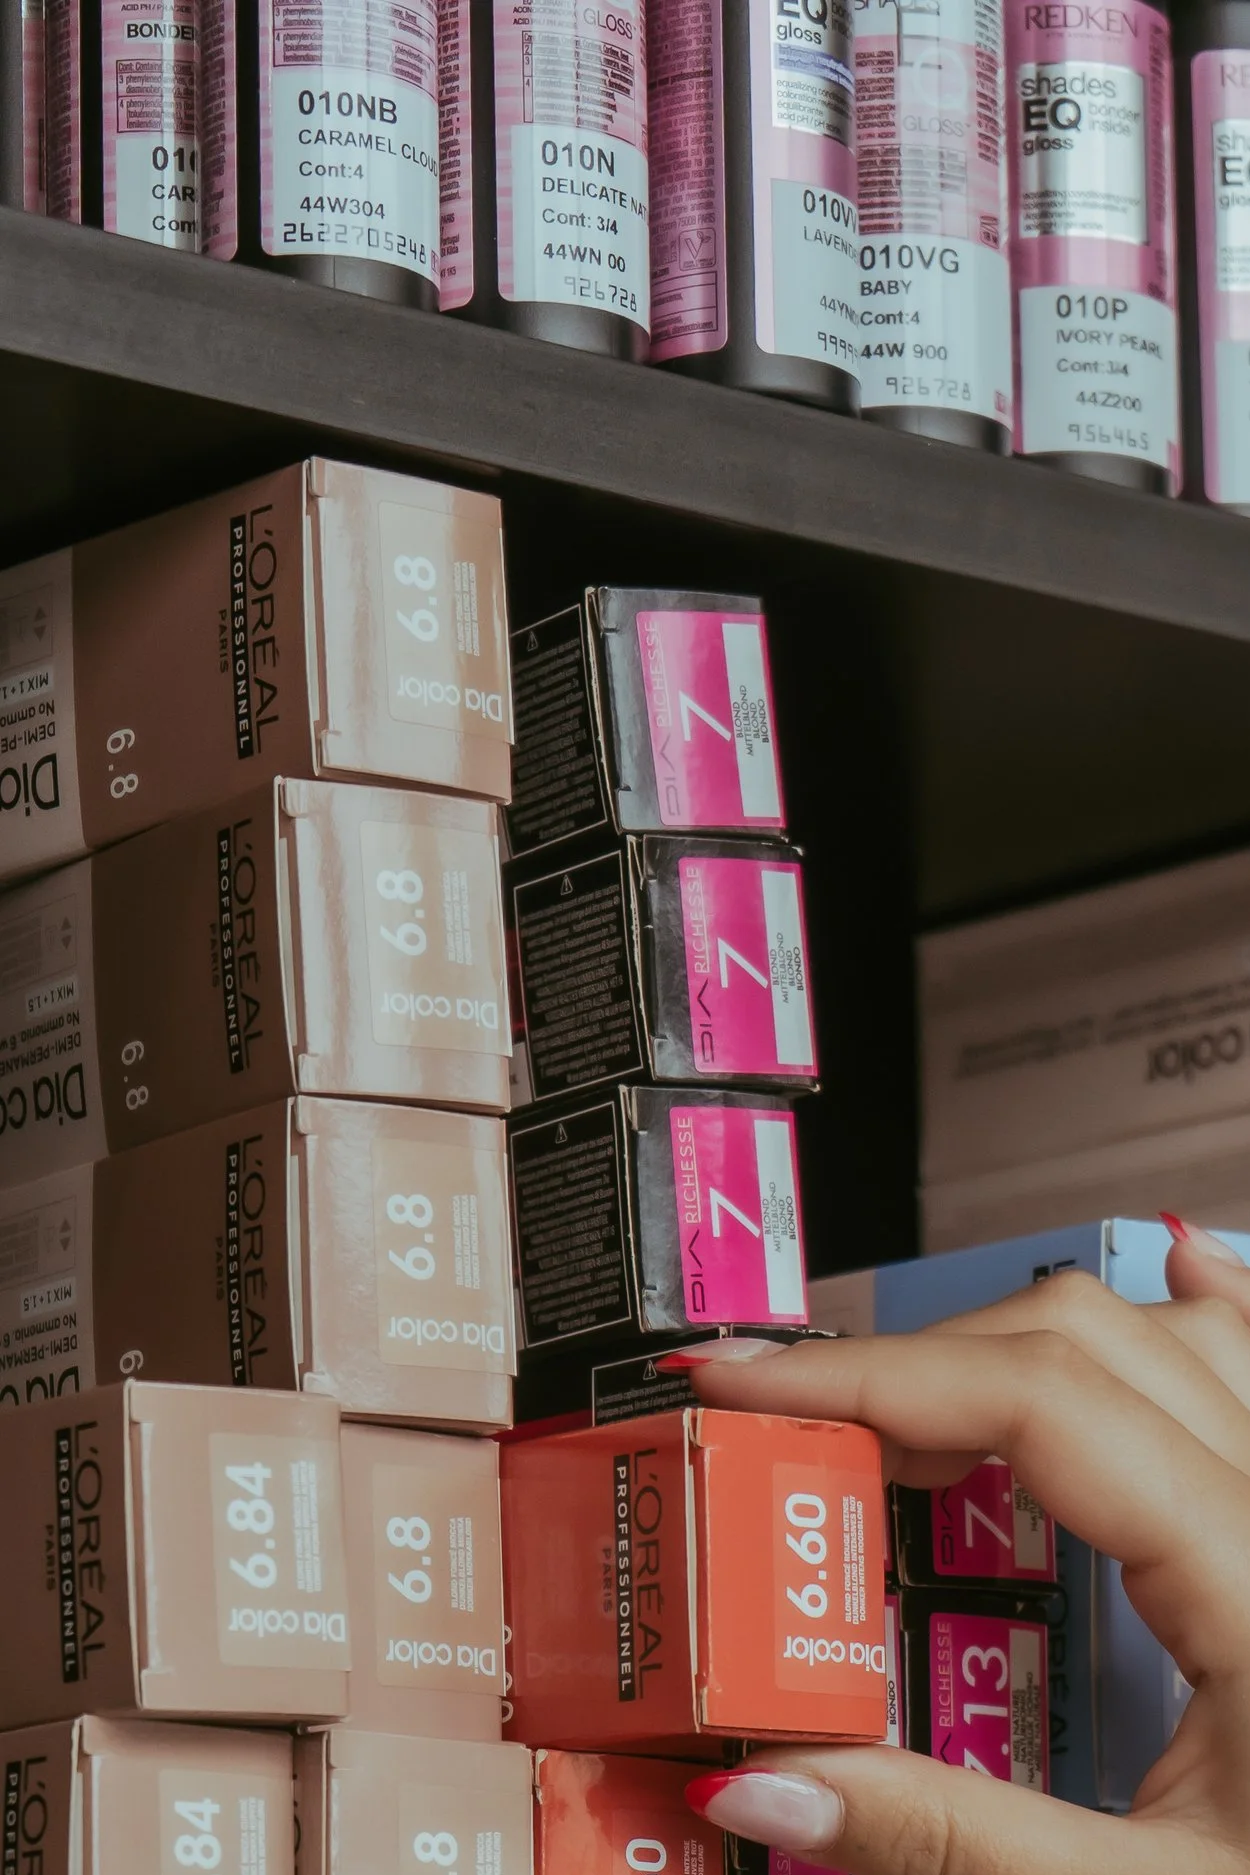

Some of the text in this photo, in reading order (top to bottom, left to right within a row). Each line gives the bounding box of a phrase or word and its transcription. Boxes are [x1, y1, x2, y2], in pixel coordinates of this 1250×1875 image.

[777, 22, 822, 44] gloss
[1025, 4, 1139, 38] REDKEN
[298, 90, 397, 124] 010NB
[1021, 72, 1117, 99] shades
[1023, 98, 1082, 132] EQ
[298, 129, 396, 156] CARAMEL
[541, 140, 616, 178] 010N
[1023, 135, 1074, 156] gloss
[299, 161, 364, 180] Cont:4
[542, 177, 628, 209] DELICATE
[300, 196, 385, 220] 44W304
[542, 208, 619, 236] Cont: 3/4
[283, 222, 427, 265] 2622705248
[543, 243, 626, 274] 44WN 00
[860, 244, 960, 274] 010VG
[564, 276, 637, 313] 926728
[861, 279, 912, 297] BABY
[1056, 294, 1128, 321] 010P
[860, 311, 920, 326] Cont:4
[861, 342, 948, 360] 44W 900
[1056, 329, 1164, 360] IVORY PEARL
[393, 555, 440, 643] 6.8
[217, 609, 229, 674] PARIS
[233, 525, 250, 750] PROFESSIONNEL
[248, 504, 280, 754] L'ORÉAL
[397, 674, 503, 723] Dia color
[644, 621, 671, 729] RICHESSE
[679, 690, 731, 742] 7
[106, 728, 139, 799] 6.8
[376, 869, 427, 956] 6.8
[686, 866, 706, 972] RICHESSE
[219, 841, 240, 1062] PROFESSIONNEL
[232, 819, 263, 1067] L'ORÉAL
[717, 937, 768, 989] 7
[381, 991, 498, 1030] Dia color
[33, 1062, 87, 1126] Dia
[122, 1040, 149, 1111] 6.8
[678, 1116, 699, 1225] RICHESSE
[386, 1193, 436, 1281] 6.8
[710, 1187, 760, 1238] 7
[228, 1154, 244, 1381] PROFESSIONNEL
[387, 1316, 505, 1355] Dia color
[75, 1421, 106, 1680] L'ORÉAL
[226, 1461, 279, 1590] 6.84
[44, 1524, 56, 1592] PARIS
[58, 1439, 77, 1671] PROFESSIONNEL
[386, 1515, 434, 1604] 6.8
[617, 1466, 632, 1692] PROFESSIONNEL
[633, 1448, 663, 1700] L'ORÉAL
[784, 1493, 828, 1618] 6.60
[602, 1548, 613, 1614] PARIS
[228, 1607, 347, 1644] Dia color
[386, 1639, 497, 1677] Dia color
[783, 1635, 886, 1674] Dia color
[937, 1622, 953, 1727] RICHESSE
[888, 1680, 897, 1726] BIONDO
